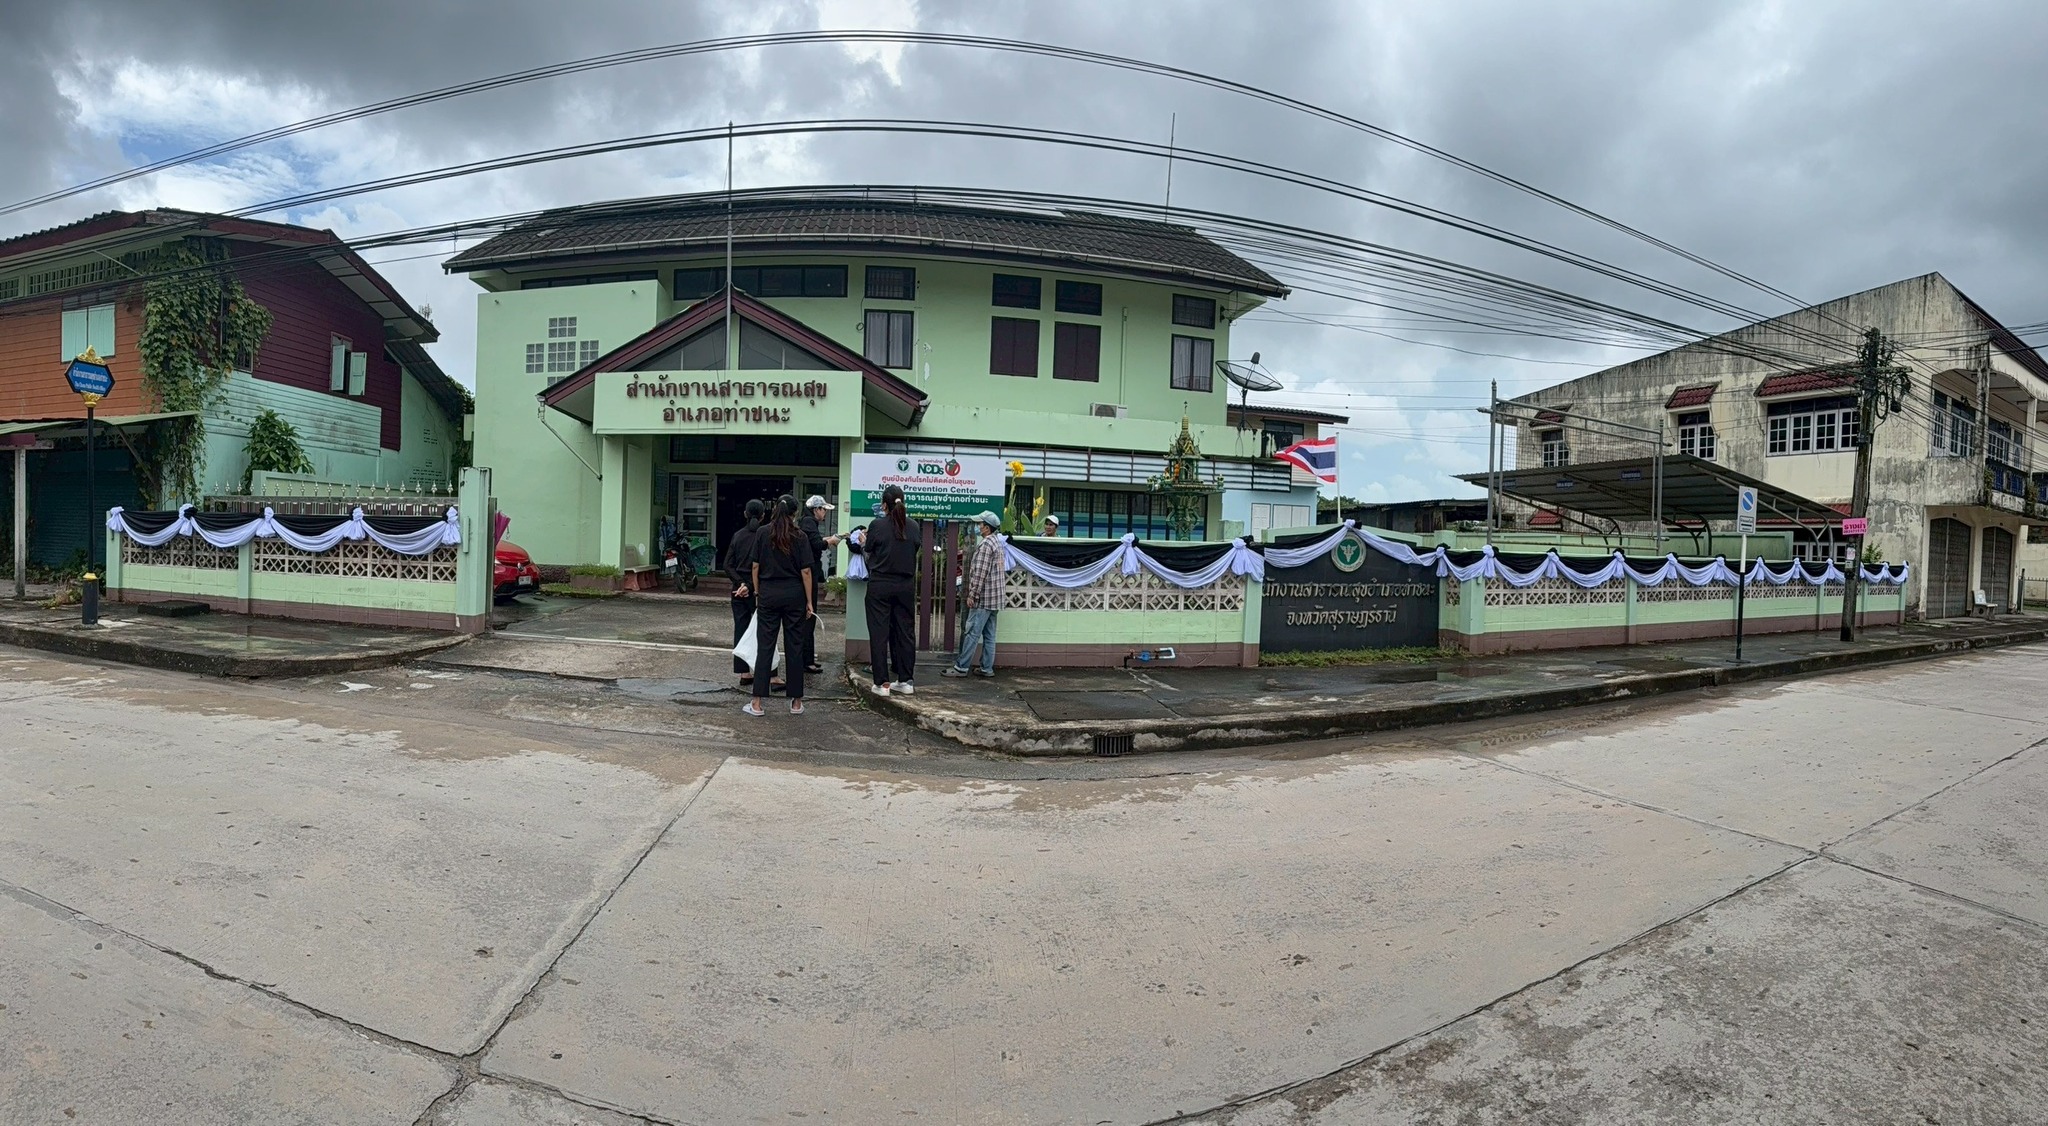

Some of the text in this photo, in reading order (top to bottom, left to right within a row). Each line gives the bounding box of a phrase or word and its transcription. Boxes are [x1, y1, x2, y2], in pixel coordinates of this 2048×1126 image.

[626, 373, 828, 407] สำนักงานสาธารณสุข
[662, 399, 791, 423] อำเภอท่าชนะ
[903, 484, 948, 493] Prevention
[950, 486, 978, 494] Center
